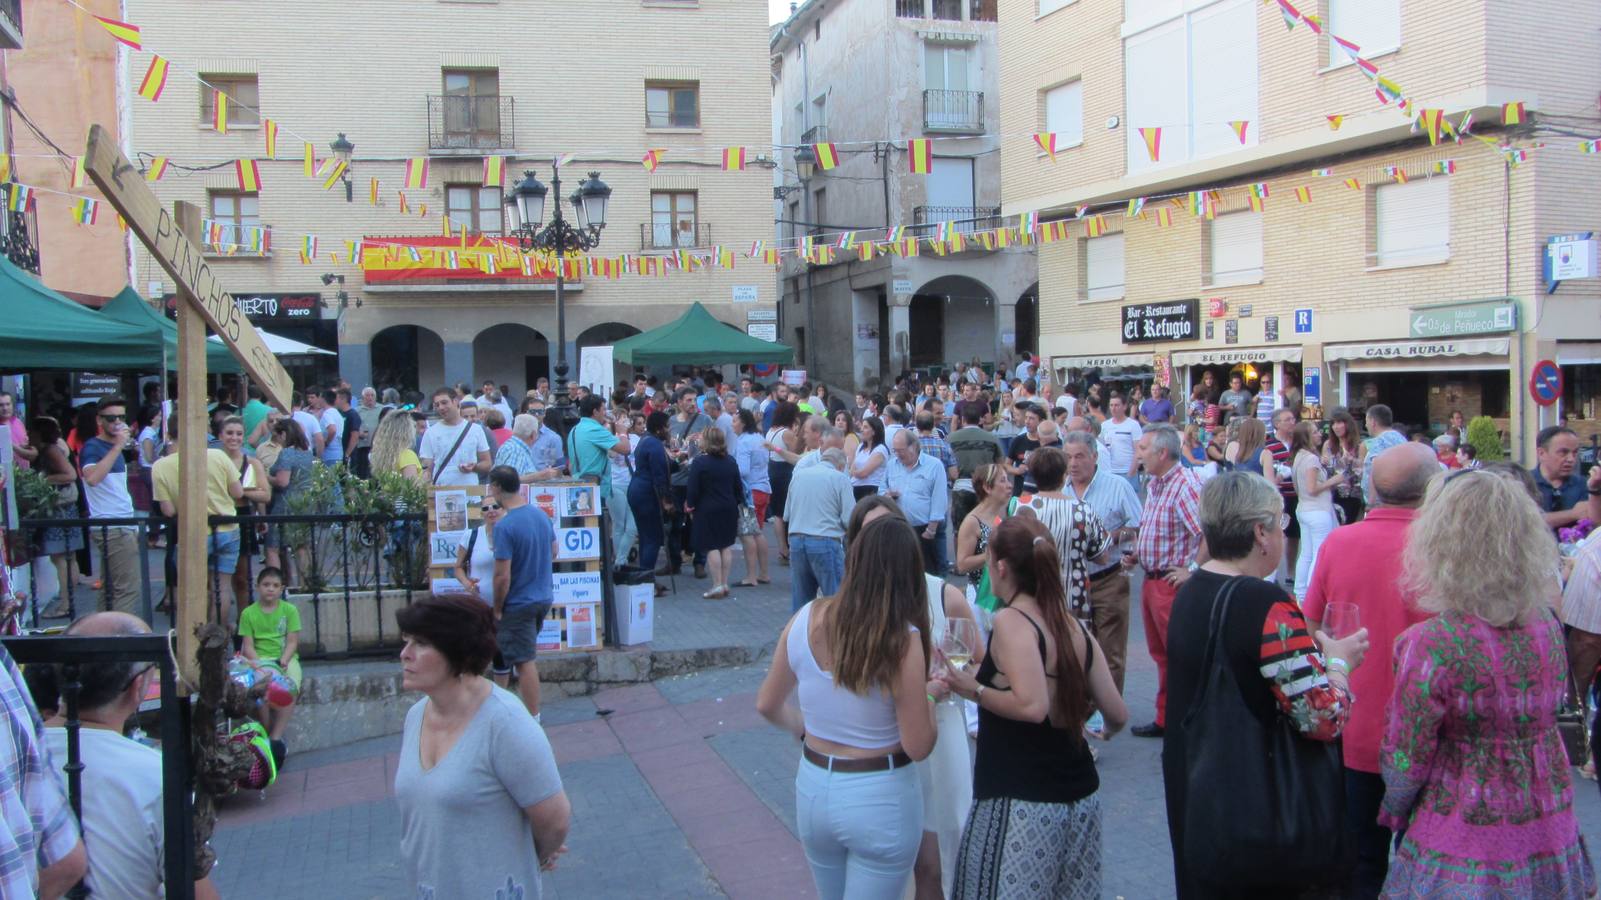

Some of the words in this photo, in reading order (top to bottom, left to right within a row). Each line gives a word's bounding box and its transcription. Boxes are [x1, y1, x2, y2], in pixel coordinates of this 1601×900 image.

[155, 207, 241, 343] PINCHOS
[287, 308, 310, 316] zero
[1298, 311, 1308, 325] R
[1124, 320, 1139, 339] El
[1143, 316, 1191, 340] Refugio
[1366, 347, 1401, 356] CASA
[1408, 344, 1456, 355] RURAL
[1220, 353, 1266, 361] REFUGIO
[565, 529, 593, 551] GD
[560, 577, 570, 585] BAR
[570, 576, 579, 584] LAS
